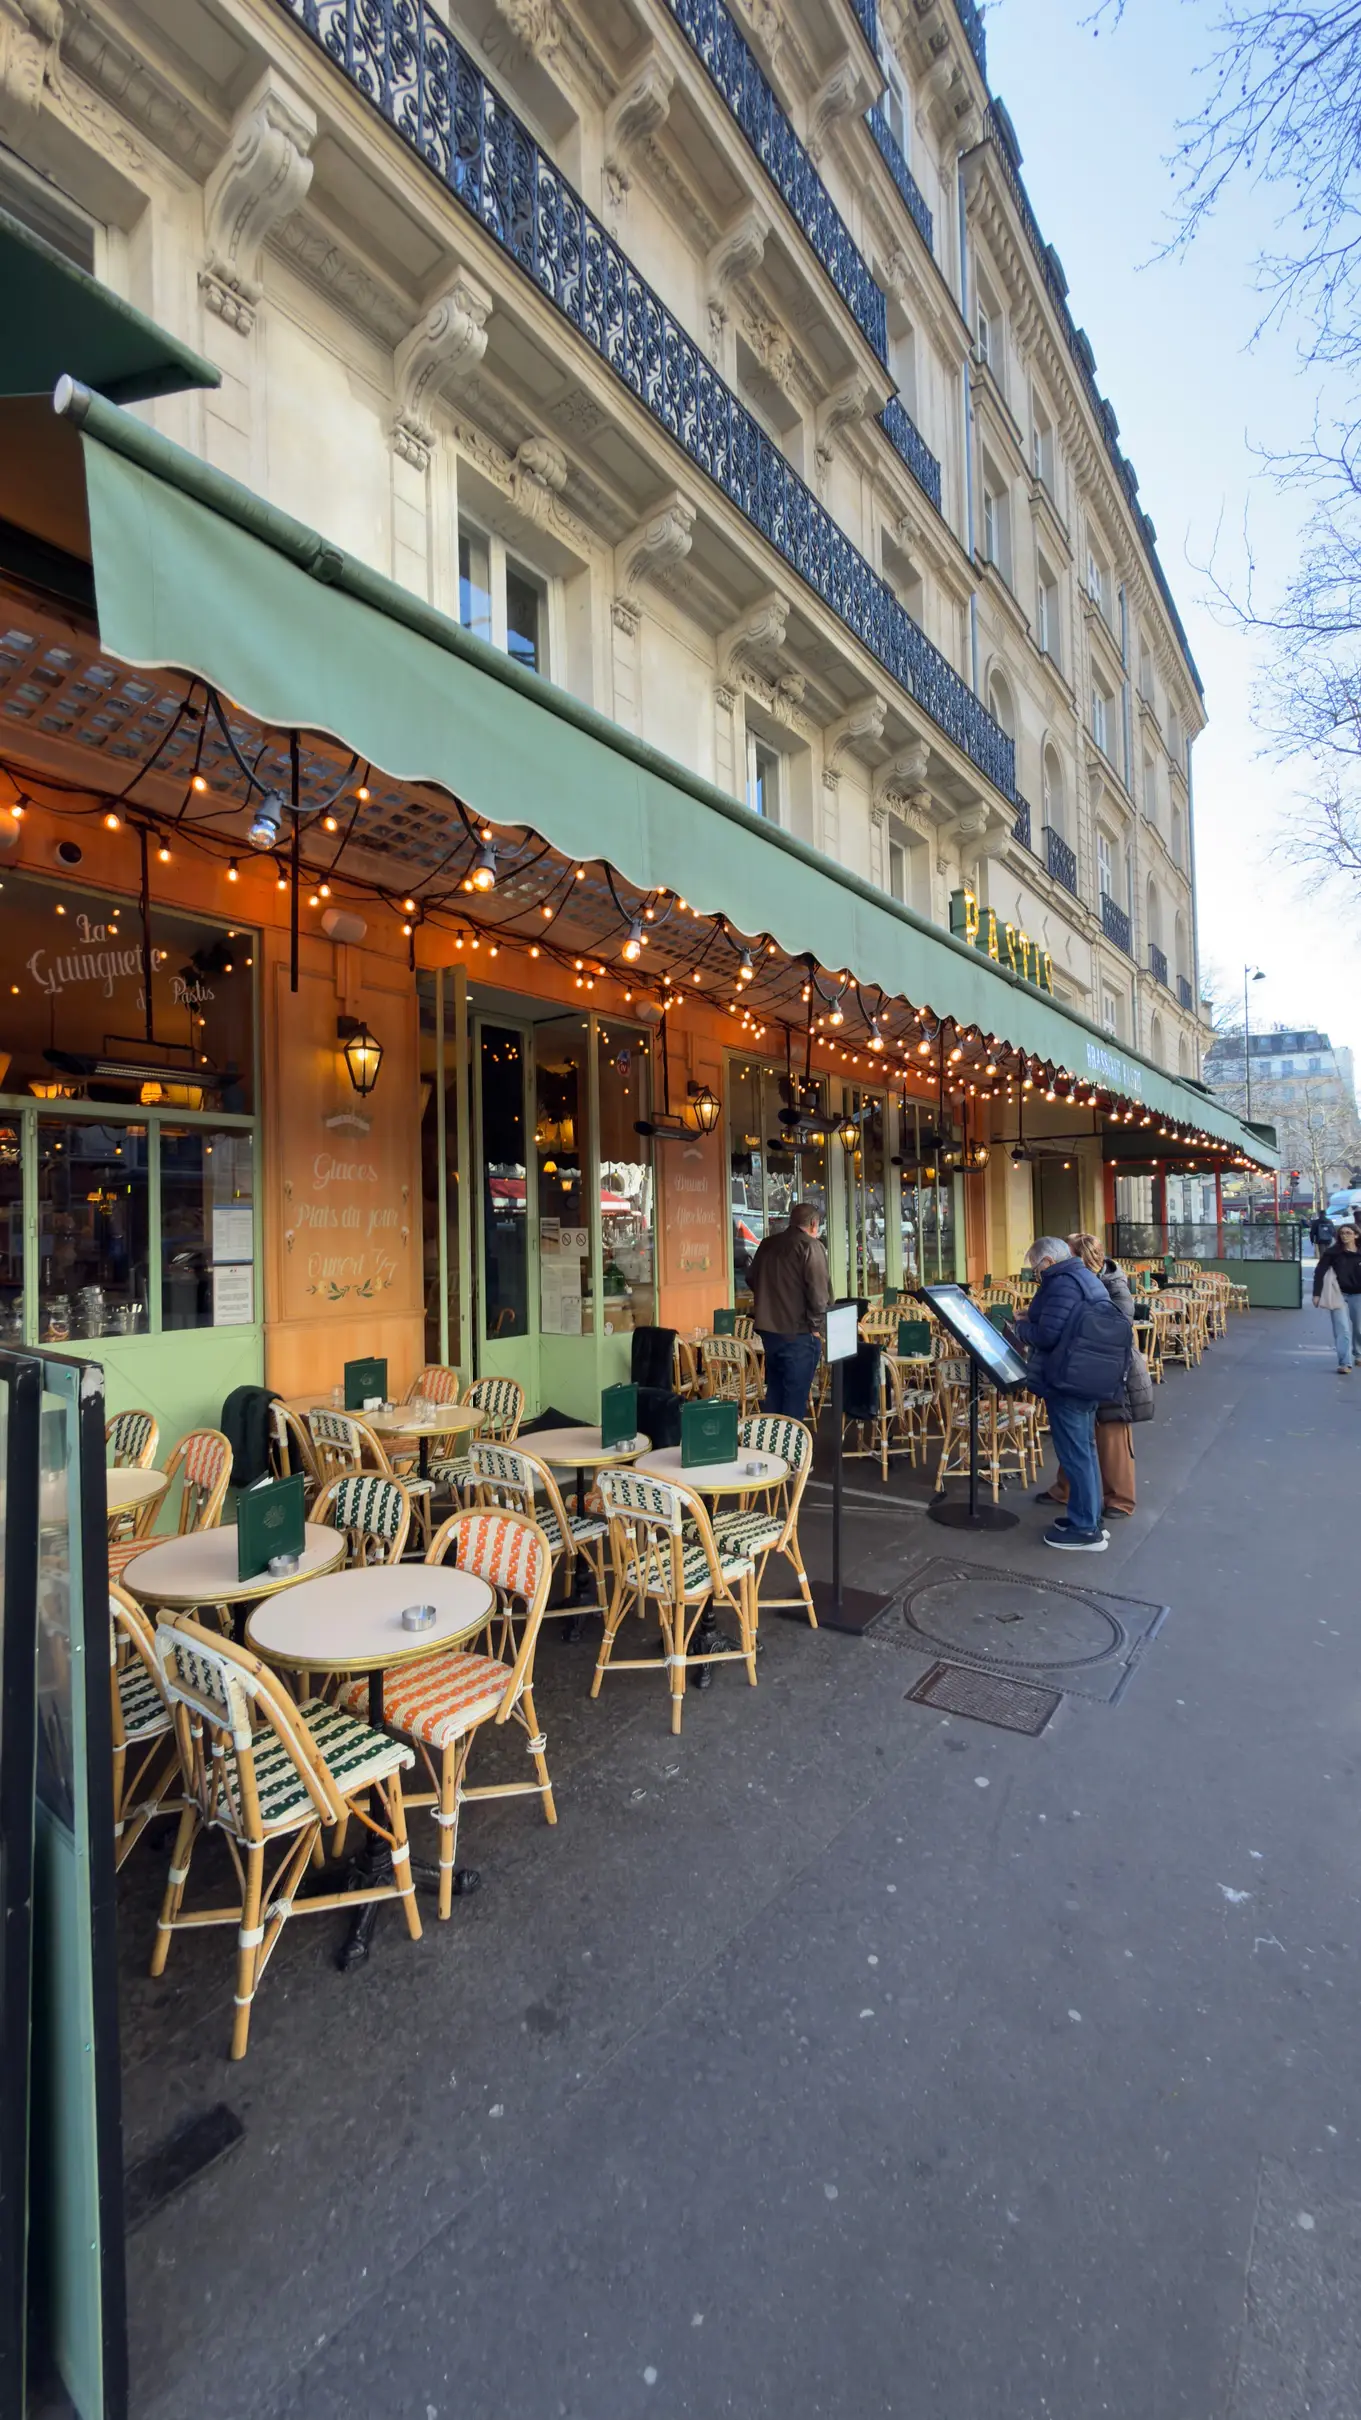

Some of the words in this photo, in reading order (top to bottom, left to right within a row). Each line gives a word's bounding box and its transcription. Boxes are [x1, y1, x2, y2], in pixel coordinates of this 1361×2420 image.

[76, 913, 110, 944] La
[26, 943, 165, 999] Guinguete
[168, 976, 216, 1005] Pastis
[312, 1152, 379, 1190] Glaces
[296, 1203, 339, 1229] Plats
[341, 1205, 361, 1229] du
[366, 1208, 399, 1238] jour
[308, 1252, 365, 1279] Ouvert
[371, 1247, 399, 1281] 7/7
